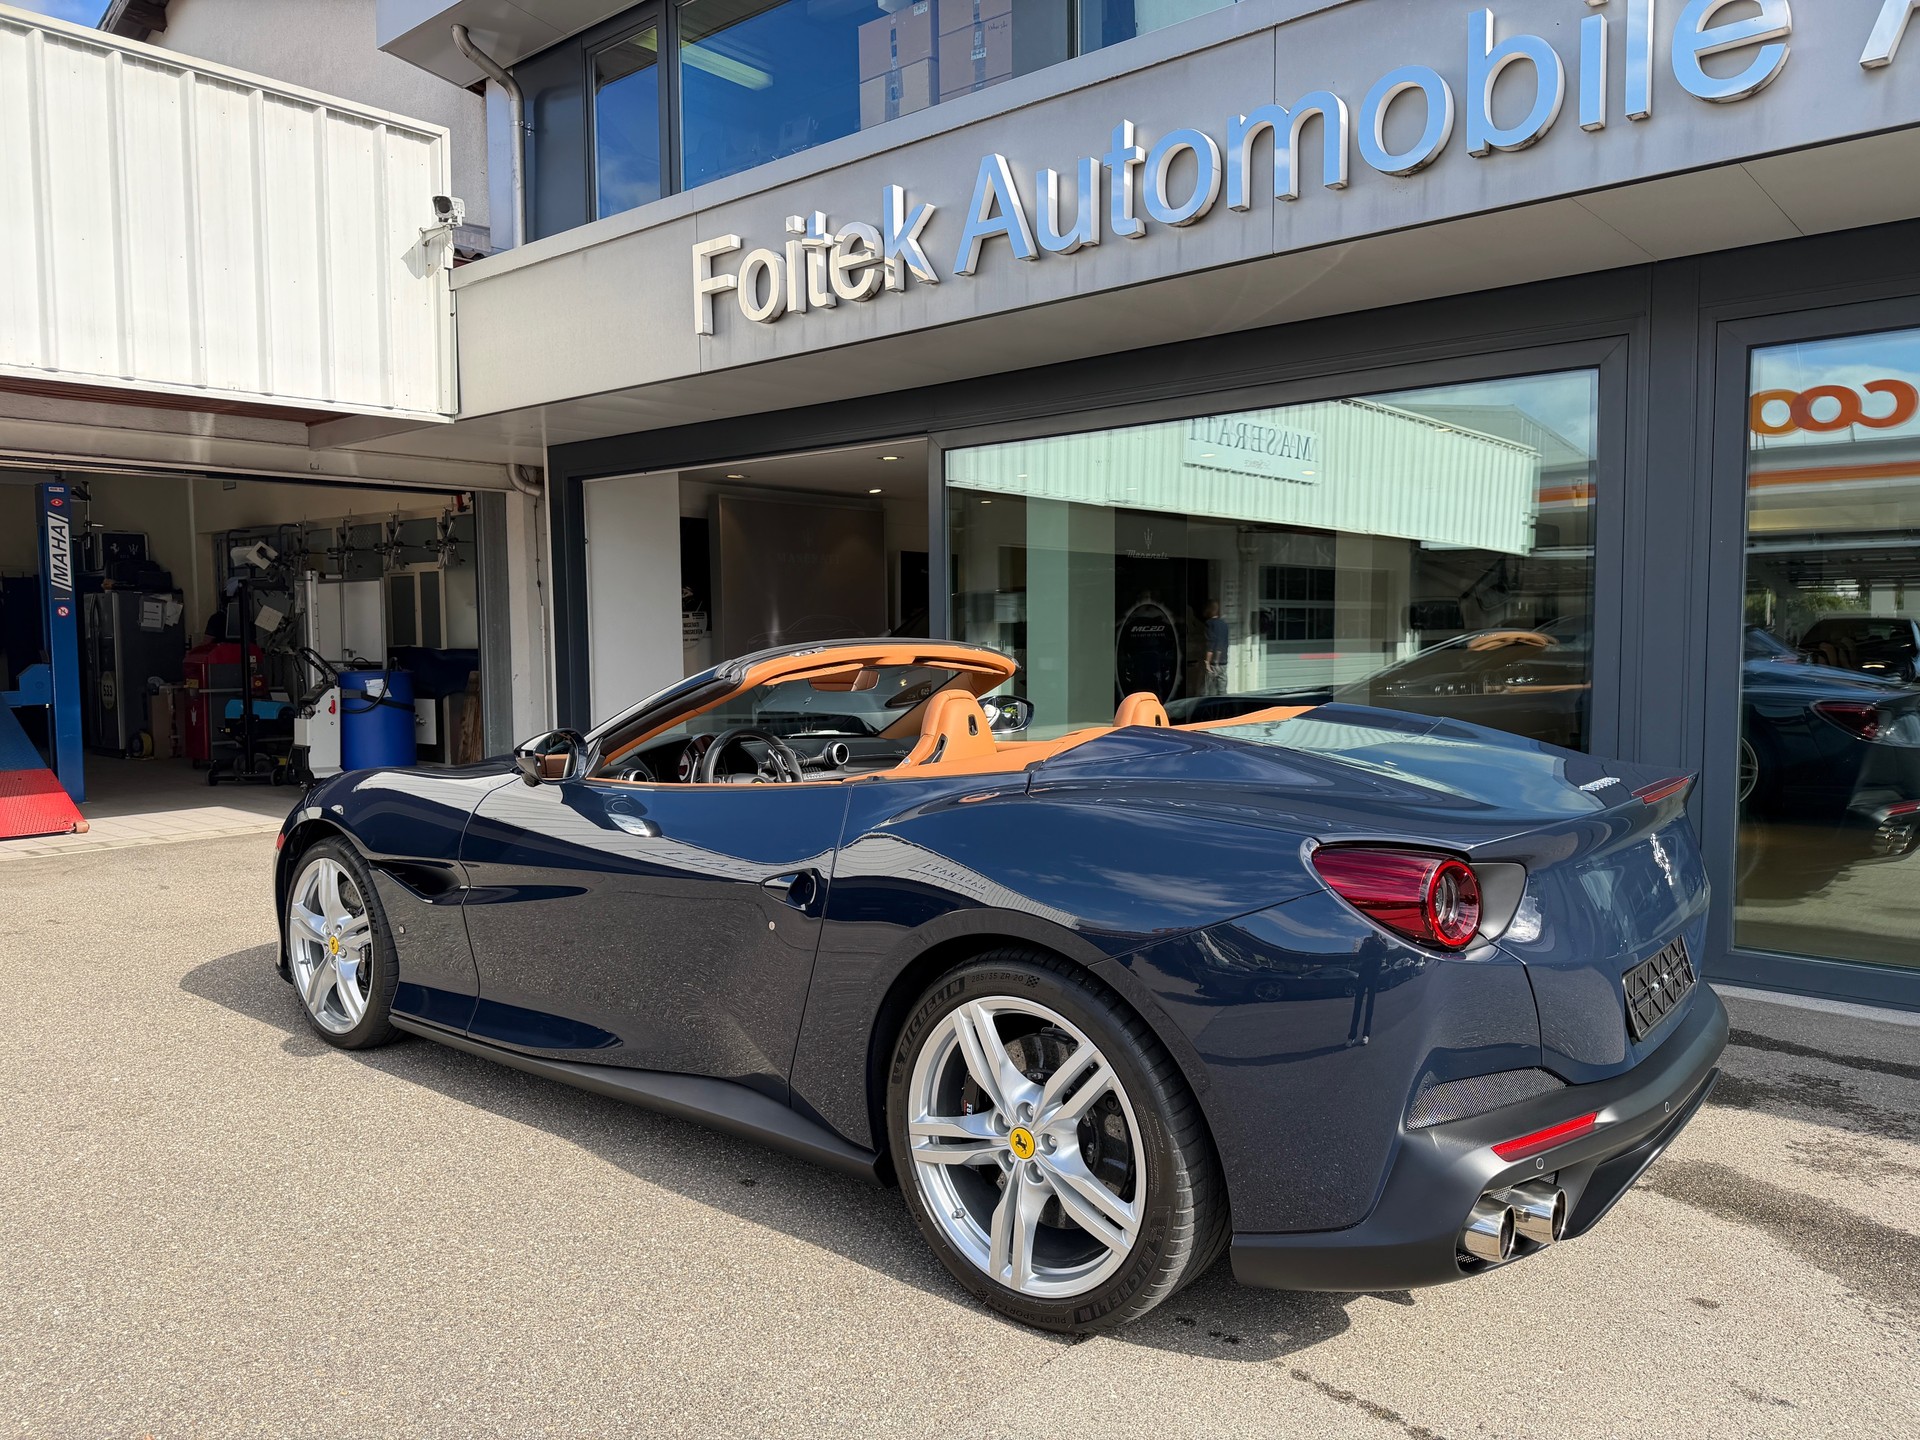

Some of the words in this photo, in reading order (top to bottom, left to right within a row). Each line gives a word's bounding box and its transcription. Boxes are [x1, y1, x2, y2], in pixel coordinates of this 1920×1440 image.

[692, 184, 940, 336] Foitek
[953, 0, 1792, 276] Automobile
[50, 525, 69, 582] MAHA
[1130, 625, 1166, 633] MC20
[103, 684, 113, 697] 533
[899, 980, 962, 1060] MICHELIN
[971, 972, 998, 983] 285/35
[1000, 972, 1011, 980] ZR
[1013, 974, 1024, 982] 20
[1077, 1246, 1157, 1322] MICHELIN
[1004, 1304, 1035, 1320] SPORT
[1040, 1316, 1067, 1325] PILOT
